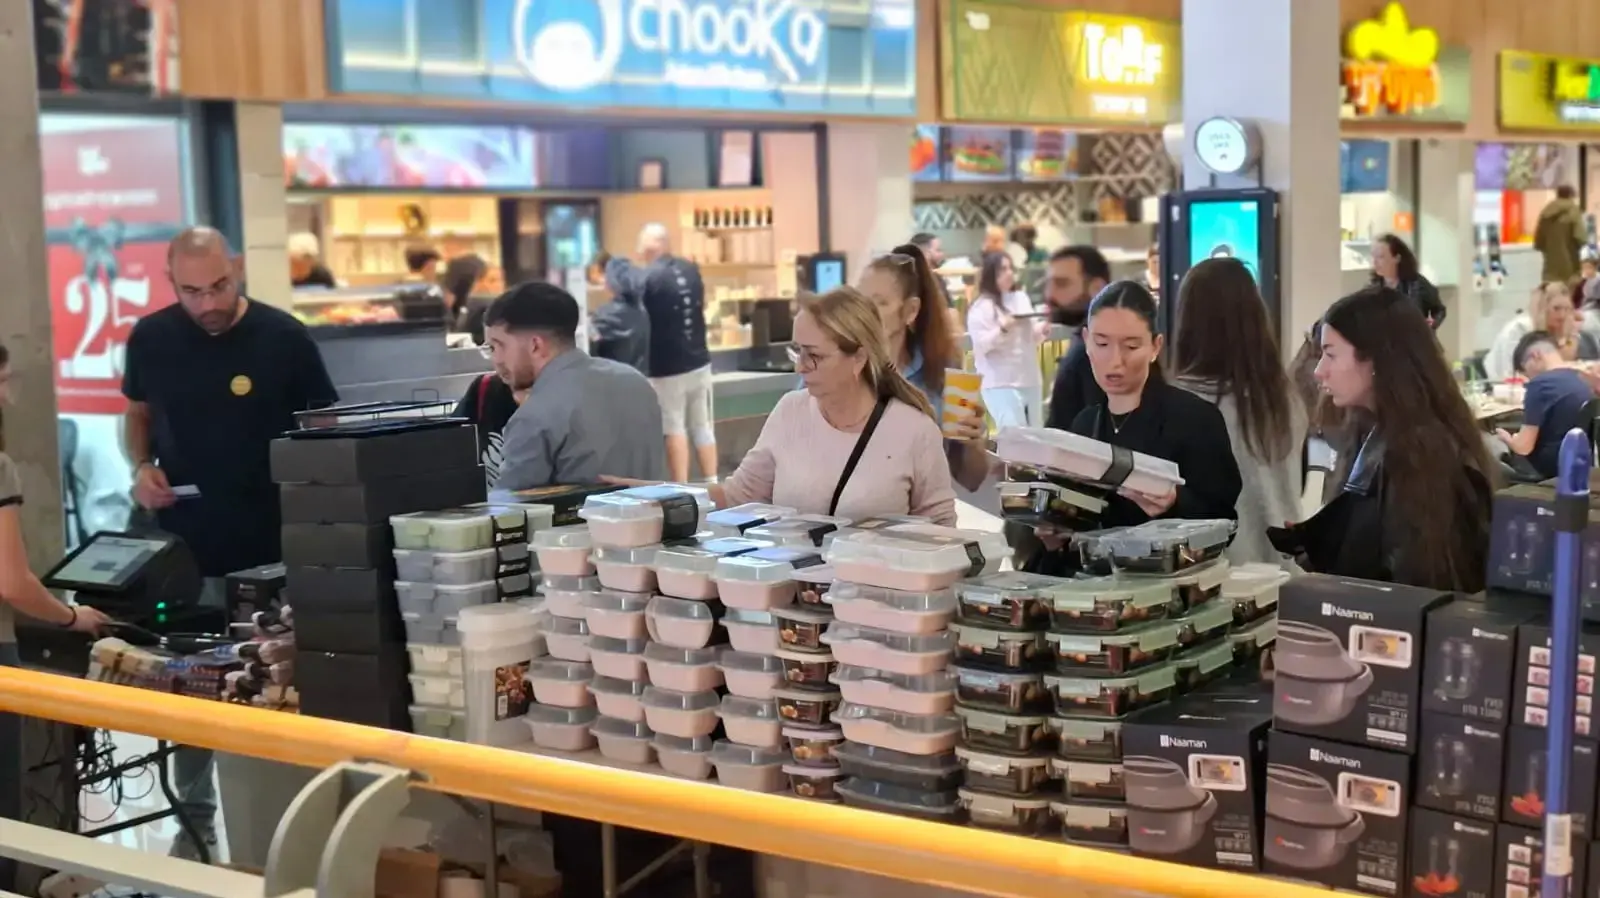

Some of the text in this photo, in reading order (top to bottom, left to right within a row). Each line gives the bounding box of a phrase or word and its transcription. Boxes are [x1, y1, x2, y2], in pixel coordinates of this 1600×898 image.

[1332, 606, 1374, 621] Naaman
[1169, 737, 1208, 749] Naaman
[1320, 751, 1362, 769] Naaman
